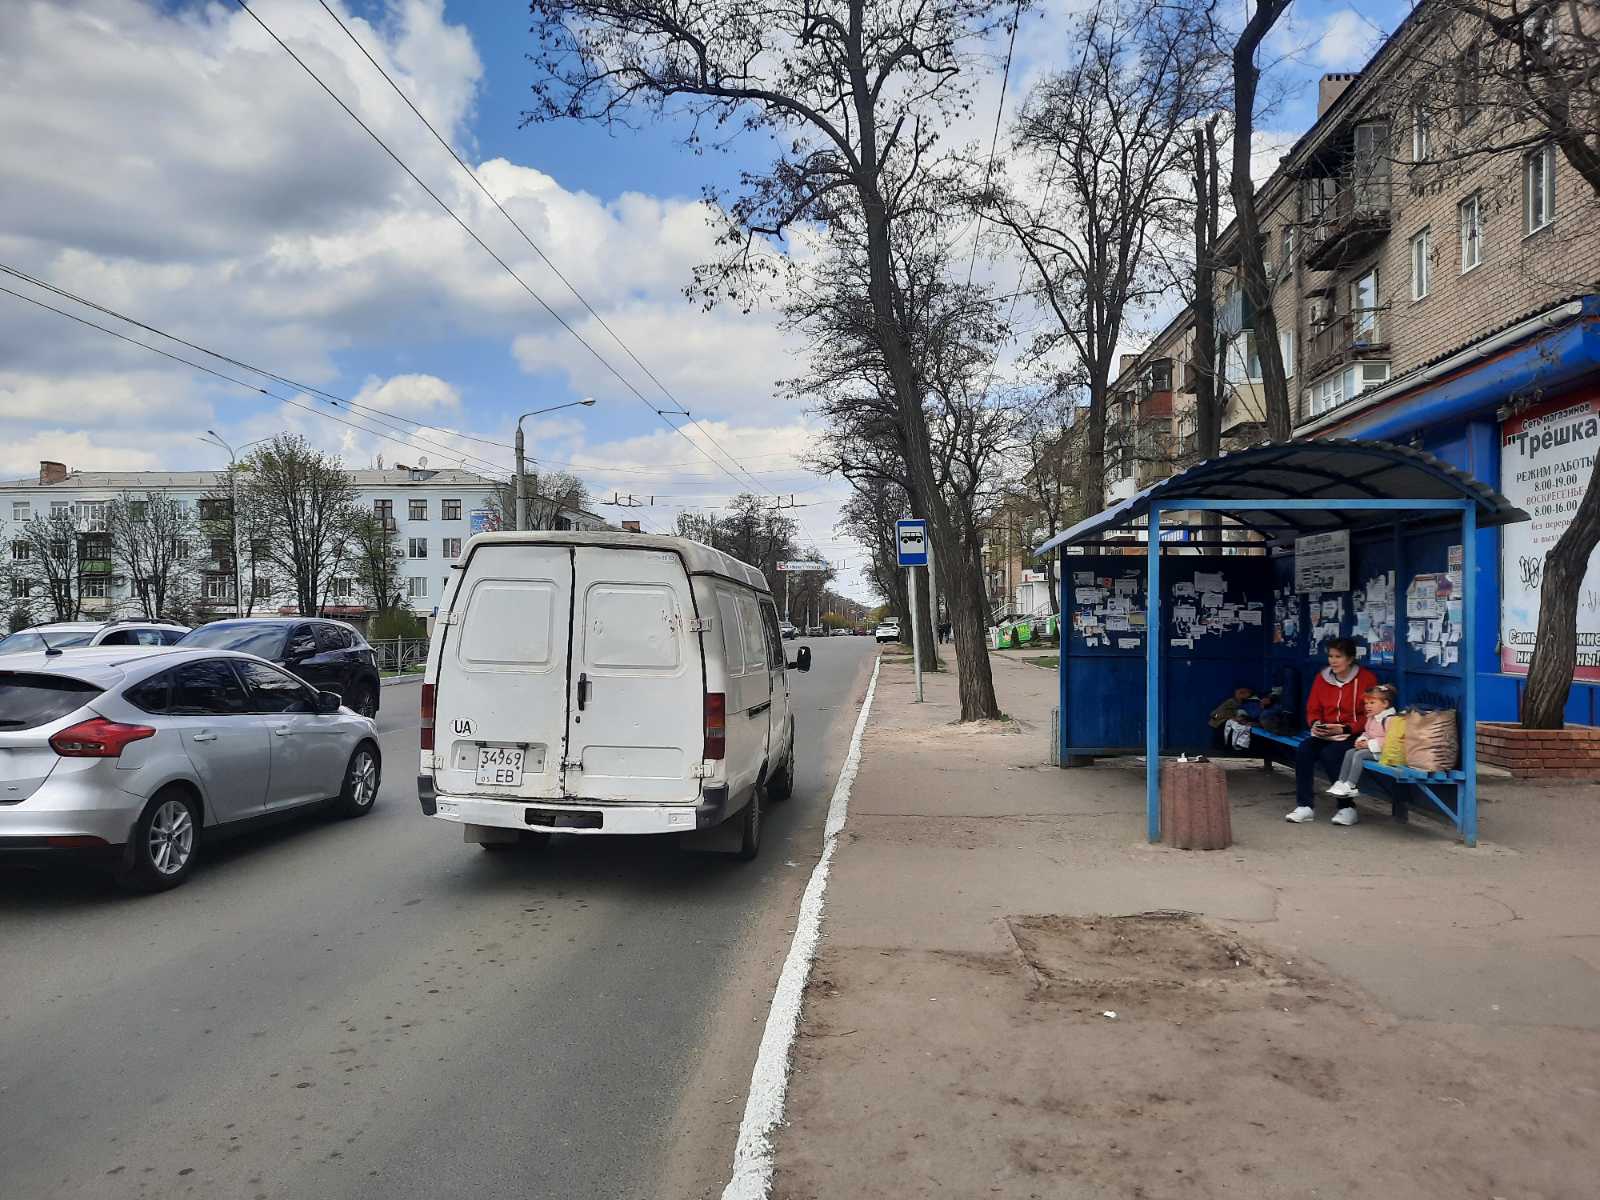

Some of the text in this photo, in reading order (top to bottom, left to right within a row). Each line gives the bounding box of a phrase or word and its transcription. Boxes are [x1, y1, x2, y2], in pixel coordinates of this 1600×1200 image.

[1522, 402, 1591, 430] Сеть магазинов
[1516, 465, 1551, 483] РЕЖИМ
[1534, 473, 1578, 492] 8.00-19.00
[1534, 499, 1578, 517] 8.00-16.00
[454, 719, 473, 735] UA
[481, 750, 522, 766] 34969
[495, 769, 514, 783] EB
